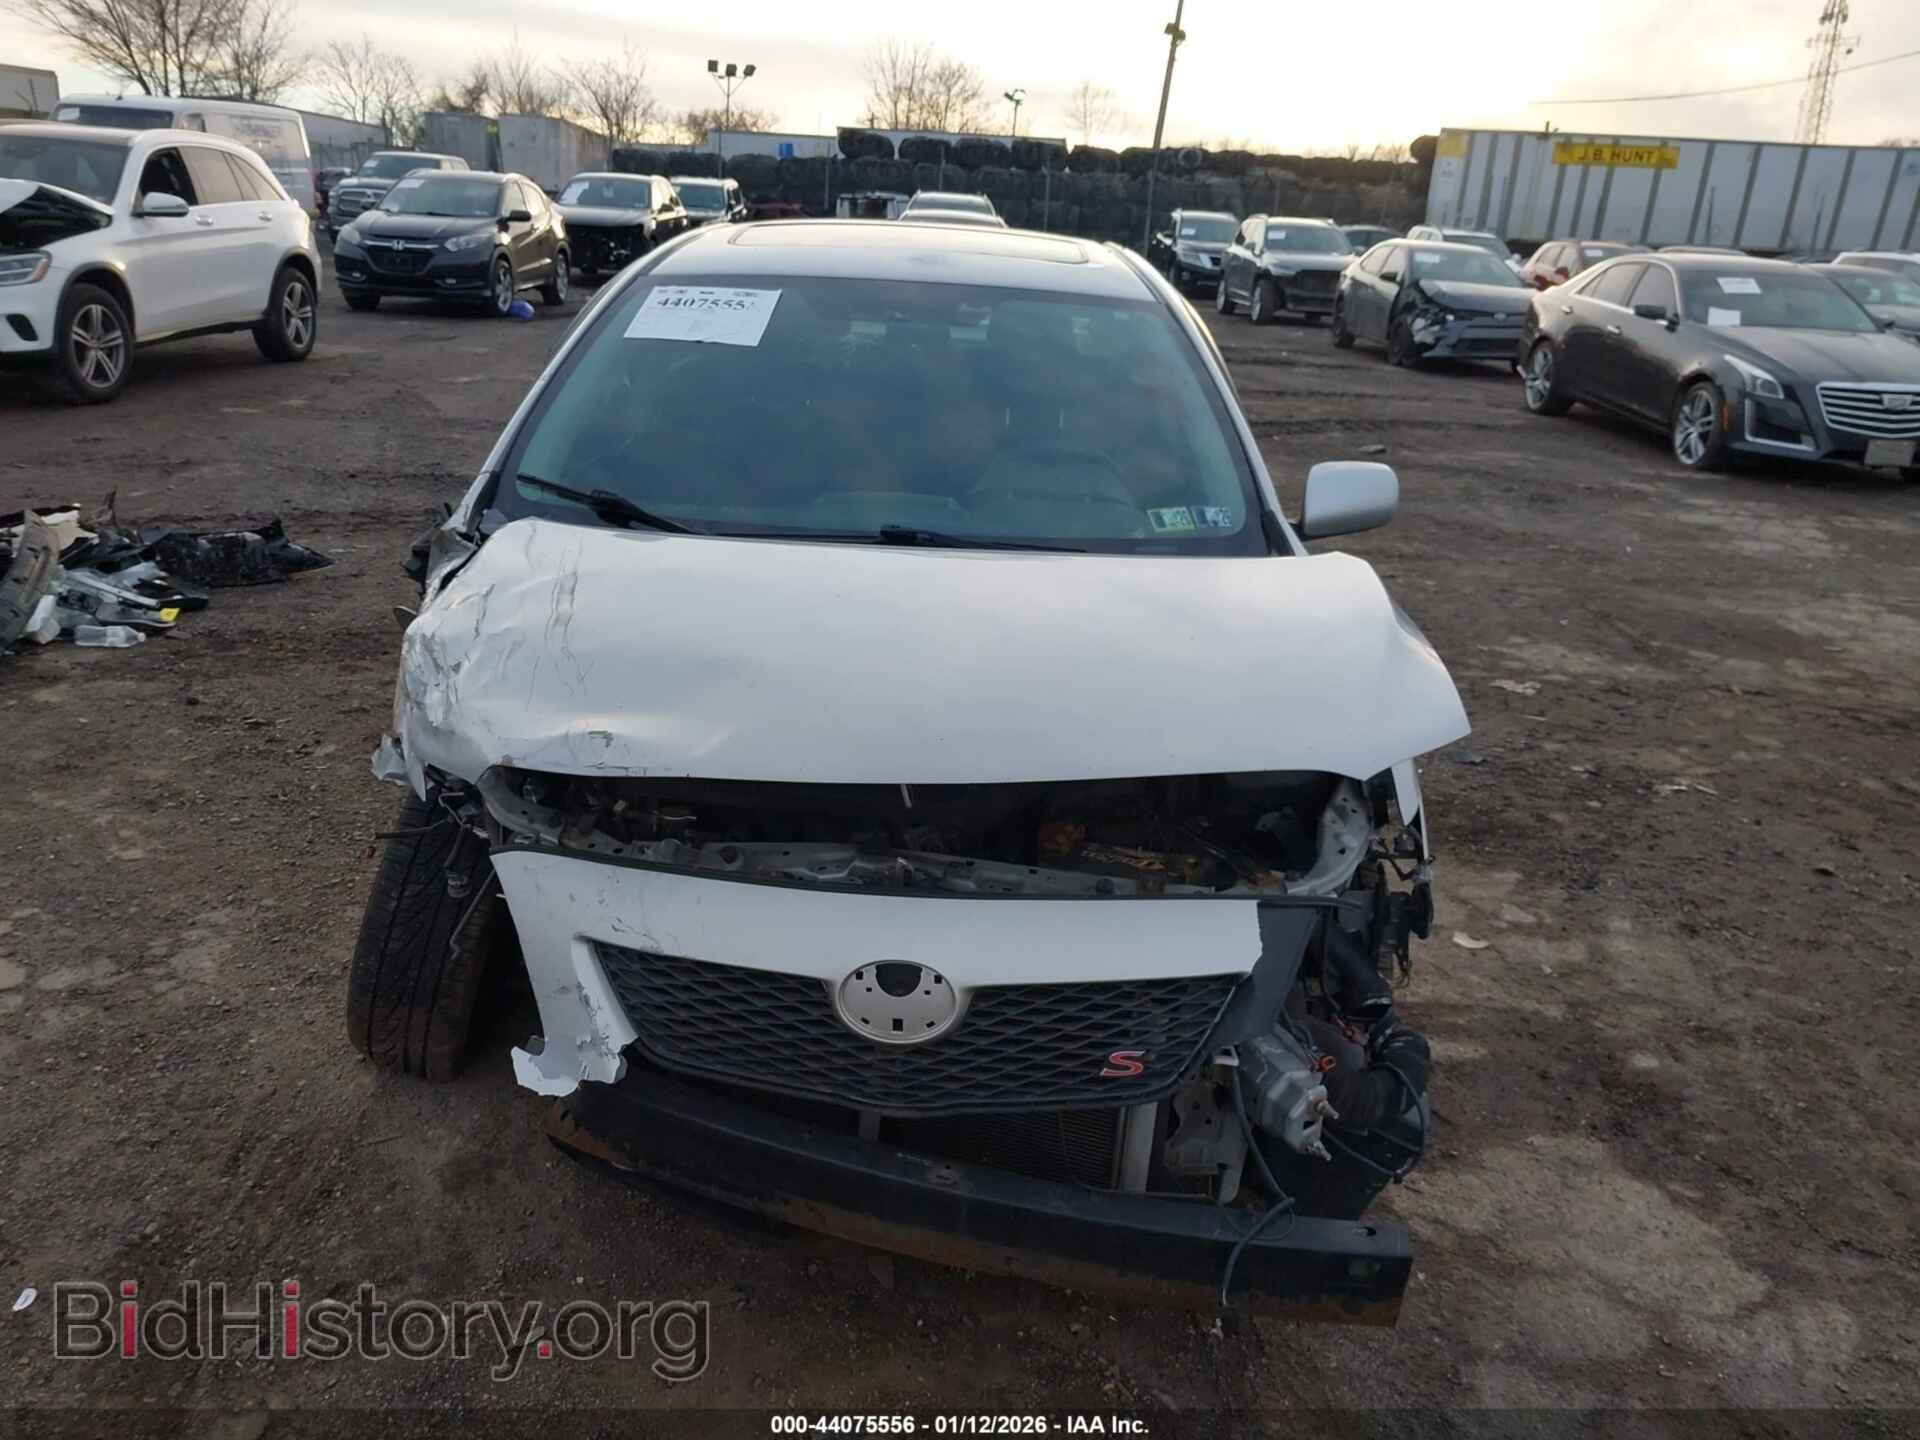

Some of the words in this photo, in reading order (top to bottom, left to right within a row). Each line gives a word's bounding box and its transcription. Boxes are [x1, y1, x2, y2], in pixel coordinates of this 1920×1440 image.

[1577, 147, 1606, 161] J.B.
[1610, 149, 1655, 163] HUNT
[1099, 1050, 1145, 1077] S
